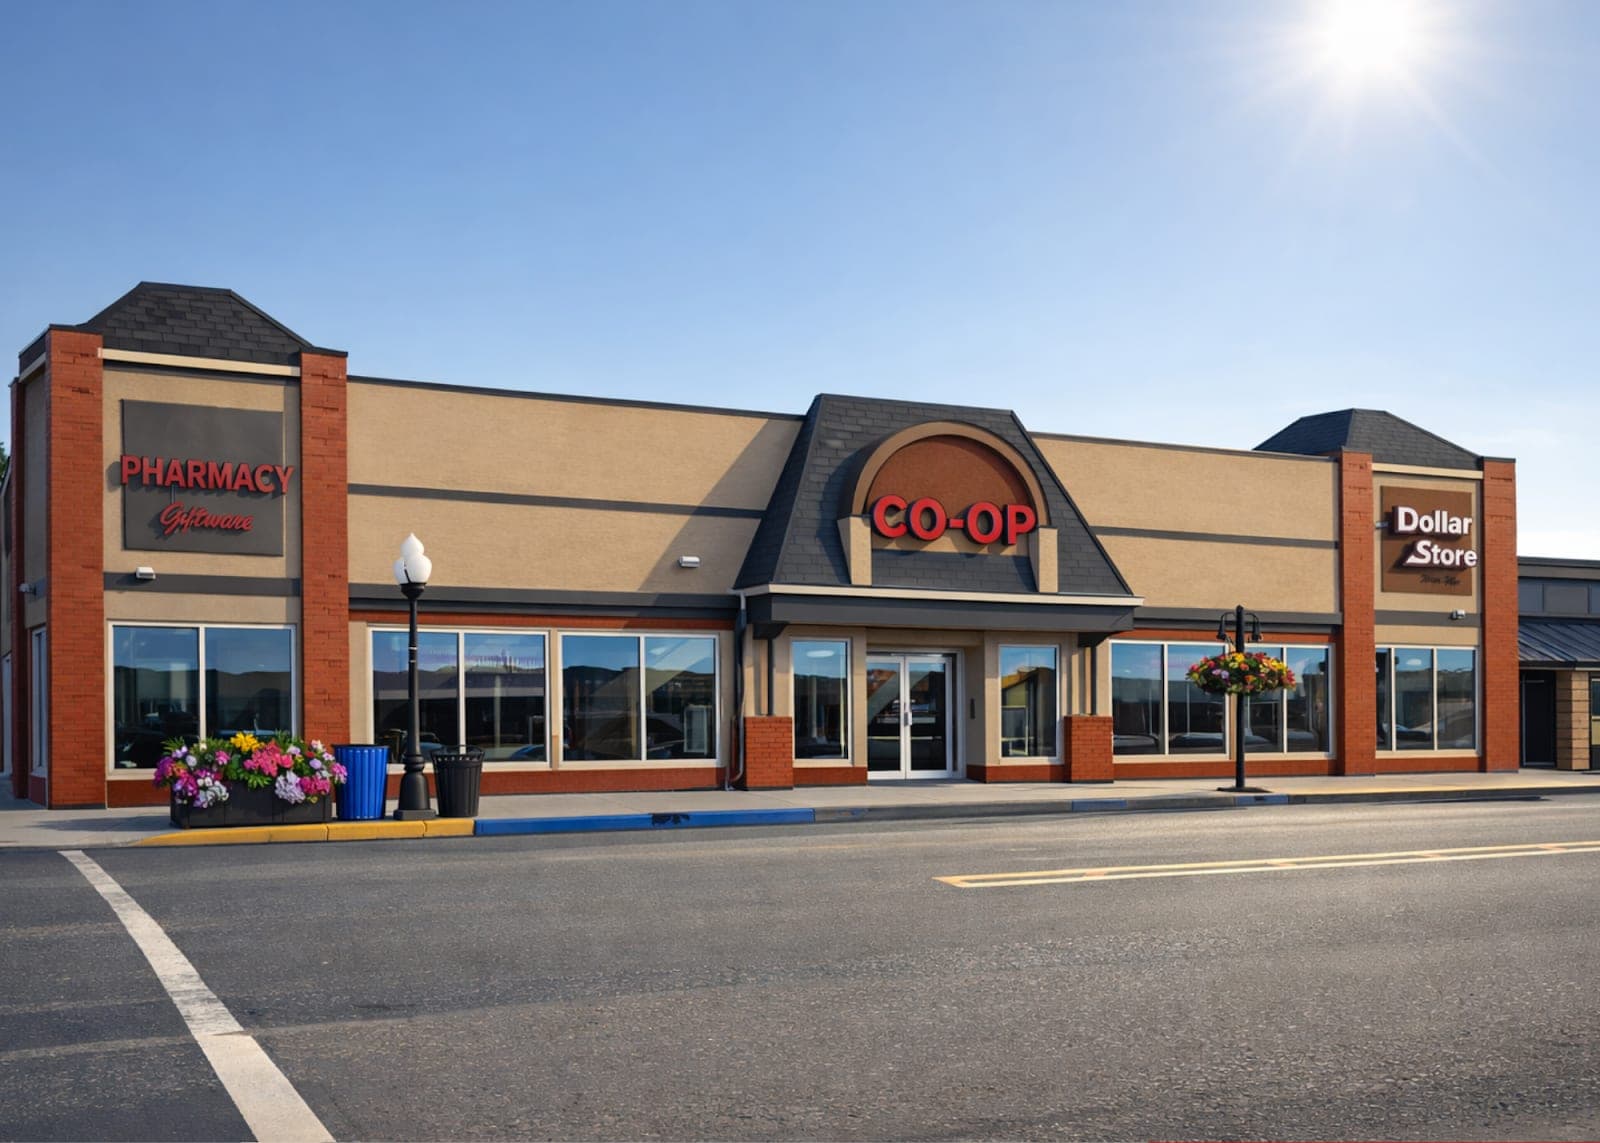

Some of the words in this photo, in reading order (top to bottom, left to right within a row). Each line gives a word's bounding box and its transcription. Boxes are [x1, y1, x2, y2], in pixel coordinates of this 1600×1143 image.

[120, 454, 295, 494] PHARMACY
[159, 501, 254, 535] Giftware
[872, 494, 1036, 545] CO-OP
[1396, 506, 1473, 535] Dollar
[1405, 539, 1478, 567] Store
